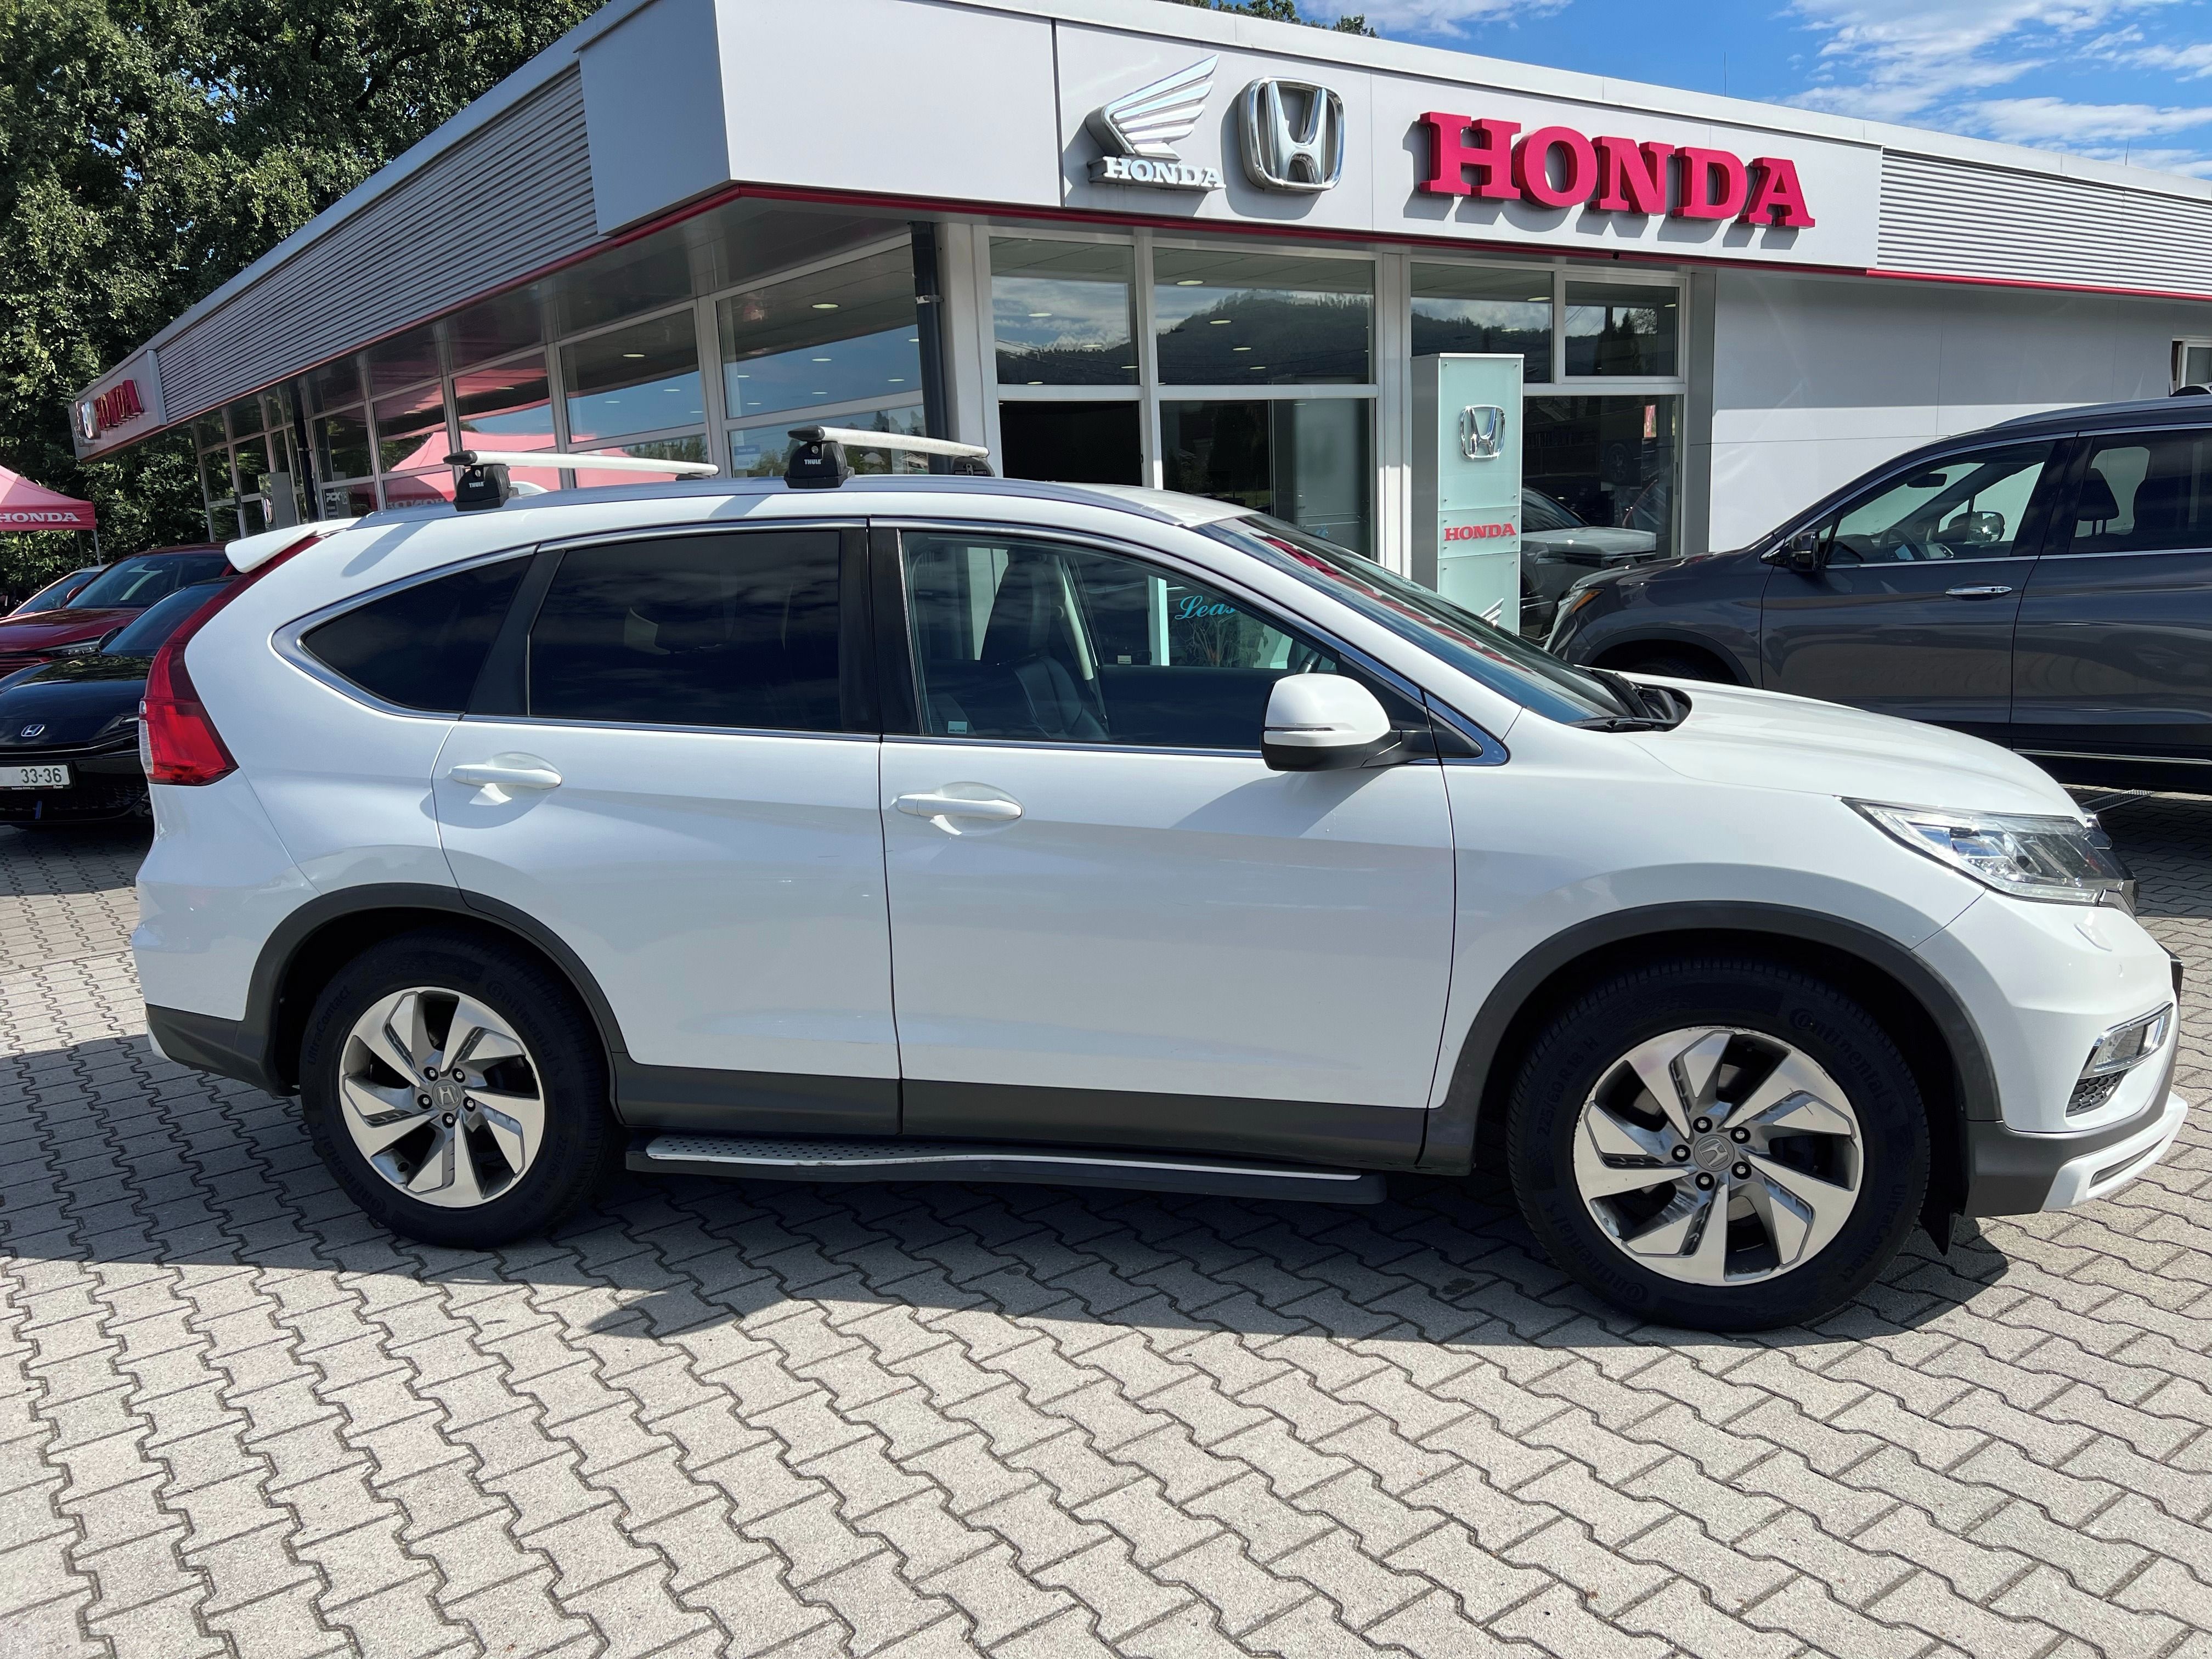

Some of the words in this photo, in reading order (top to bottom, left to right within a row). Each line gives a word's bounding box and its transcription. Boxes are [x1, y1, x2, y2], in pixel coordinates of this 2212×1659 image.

[1102, 156, 1227, 188] HONDA
[1420, 112, 1815, 228] HONDA
[0, 512, 81, 522] HONDA
[1444, 523, 1516, 541] HONDA
[21, 768, 62, 783] 33-36
